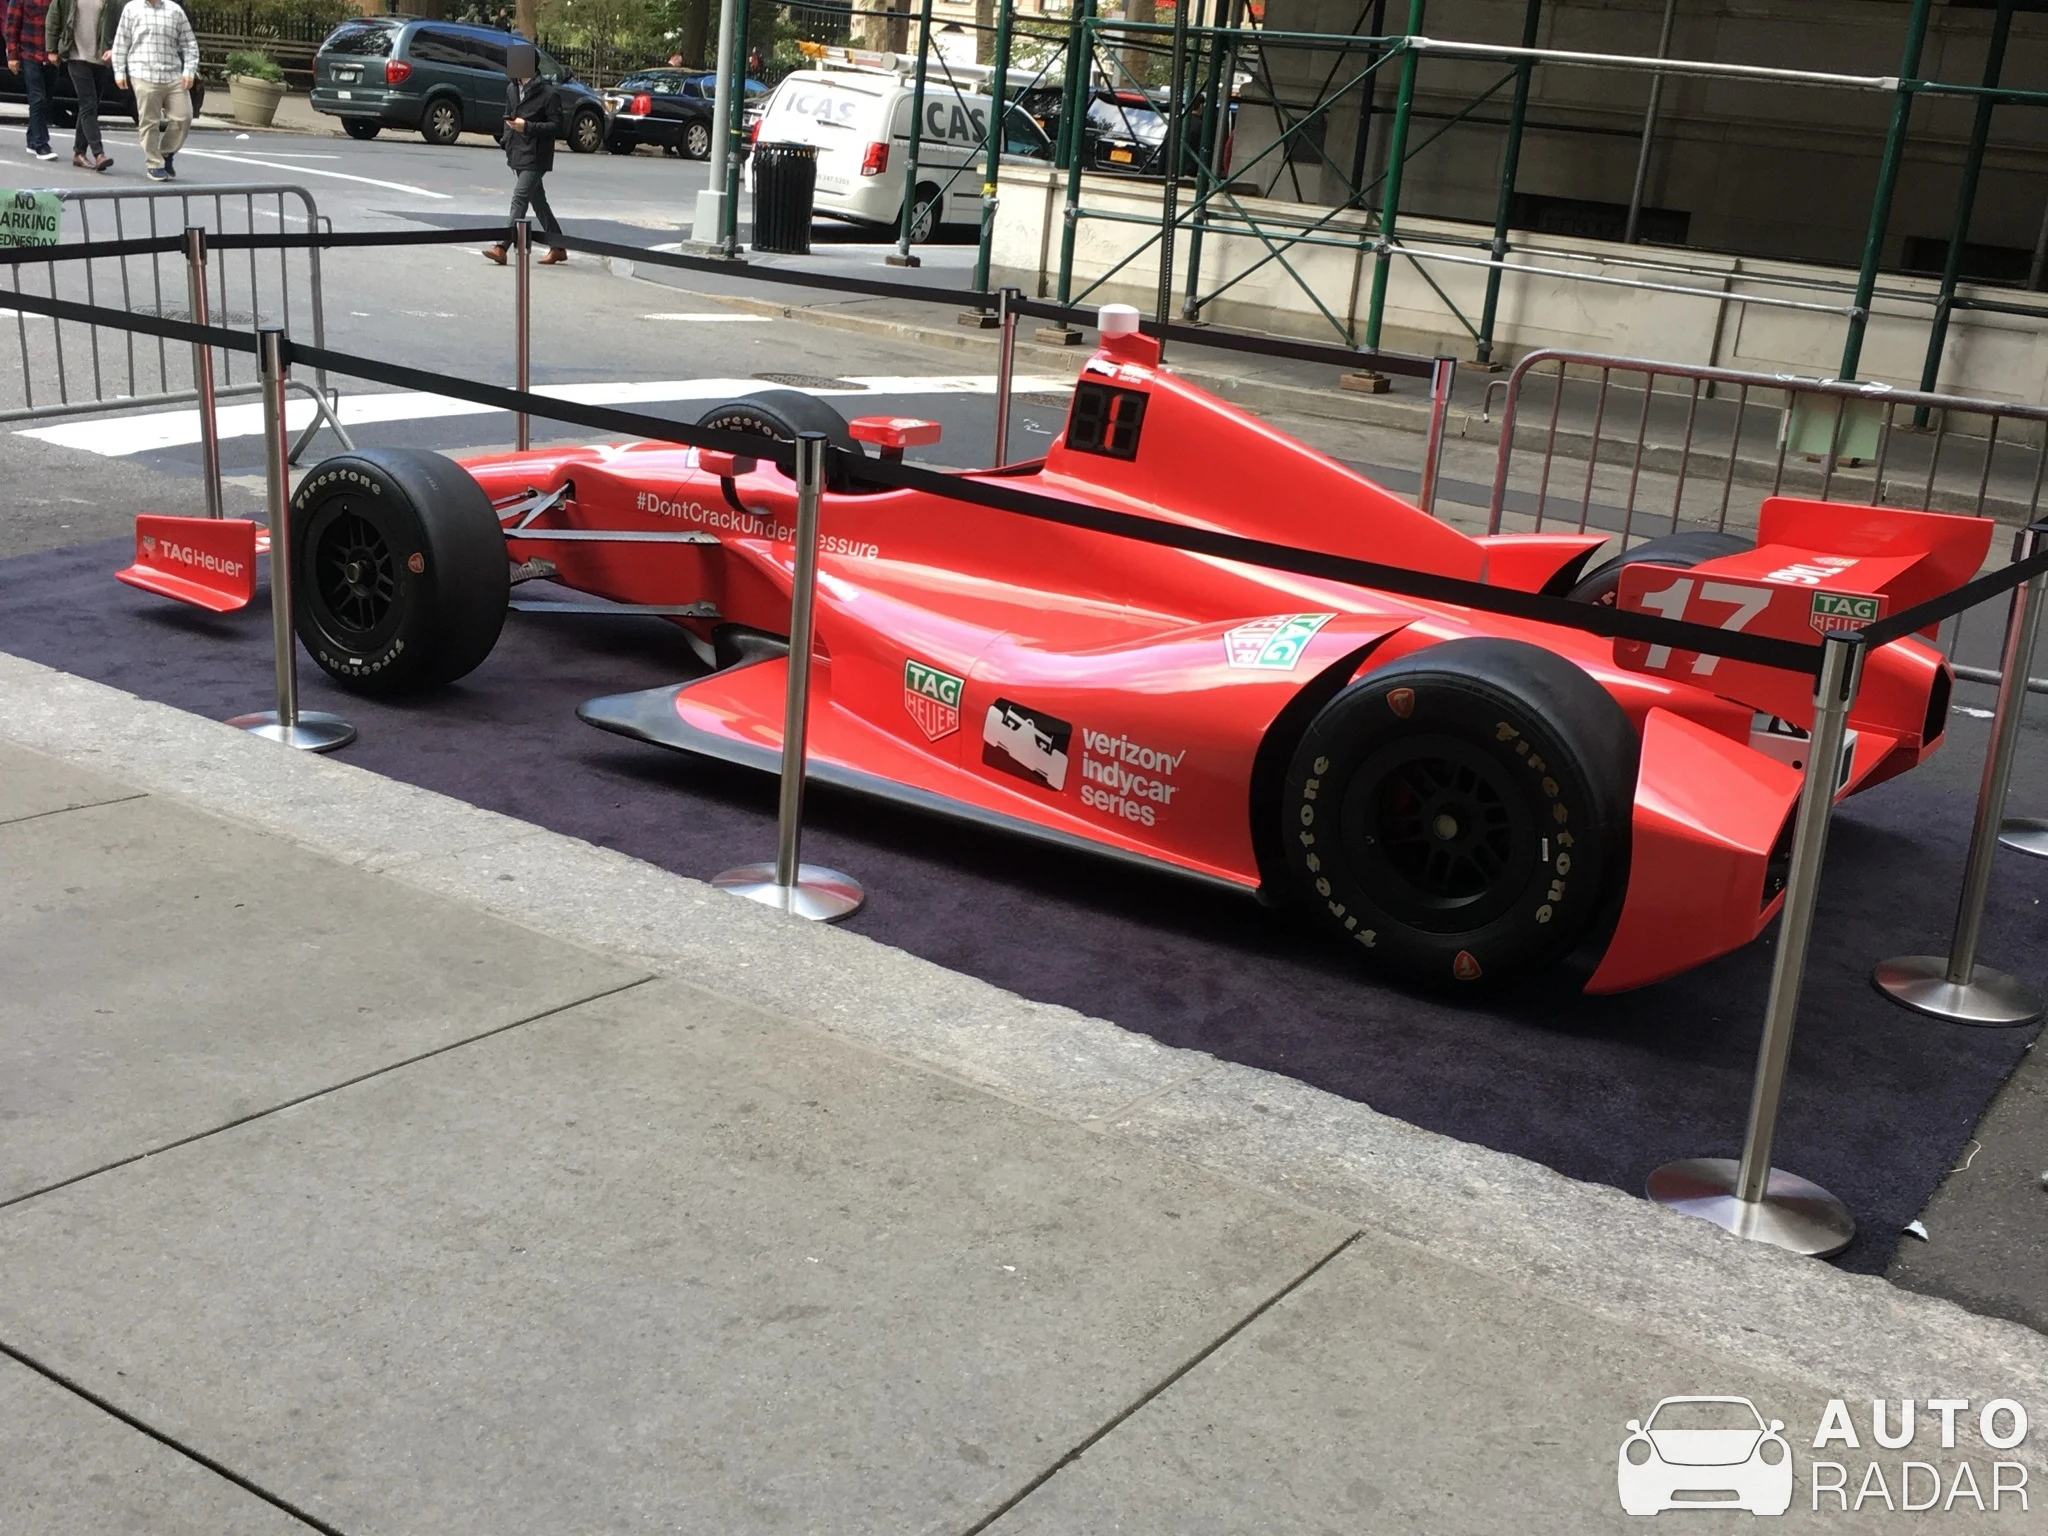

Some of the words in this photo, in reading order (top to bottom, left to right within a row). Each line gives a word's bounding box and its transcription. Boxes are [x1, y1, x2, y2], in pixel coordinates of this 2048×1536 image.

[784, 92, 857, 122] ICAS
[920, 102, 988, 143] CAS
[0, 211, 56, 231] ARKING
[15, 194, 36, 210] NO
[0, 233, 57, 248] EDNESDAY
[296, 468, 381, 510] Firestone
[637, 491, 879, 560] #DontCrackUnderessure
[1640, 577, 1774, 676] 17
[1819, 596, 1872, 618] TAG
[320, 638, 405, 677] Firestone
[1262, 614, 1330, 661] TAG
[909, 665, 957, 704] TAG
[907, 692, 957, 735] HEUER
[1082, 727, 1173, 776] verizon
[1082, 752, 1177, 805] indycar
[1080, 784, 1156, 827] series
[1495, 721, 1575, 924] Firestone
[1299, 755, 1377, 948] Firestone
